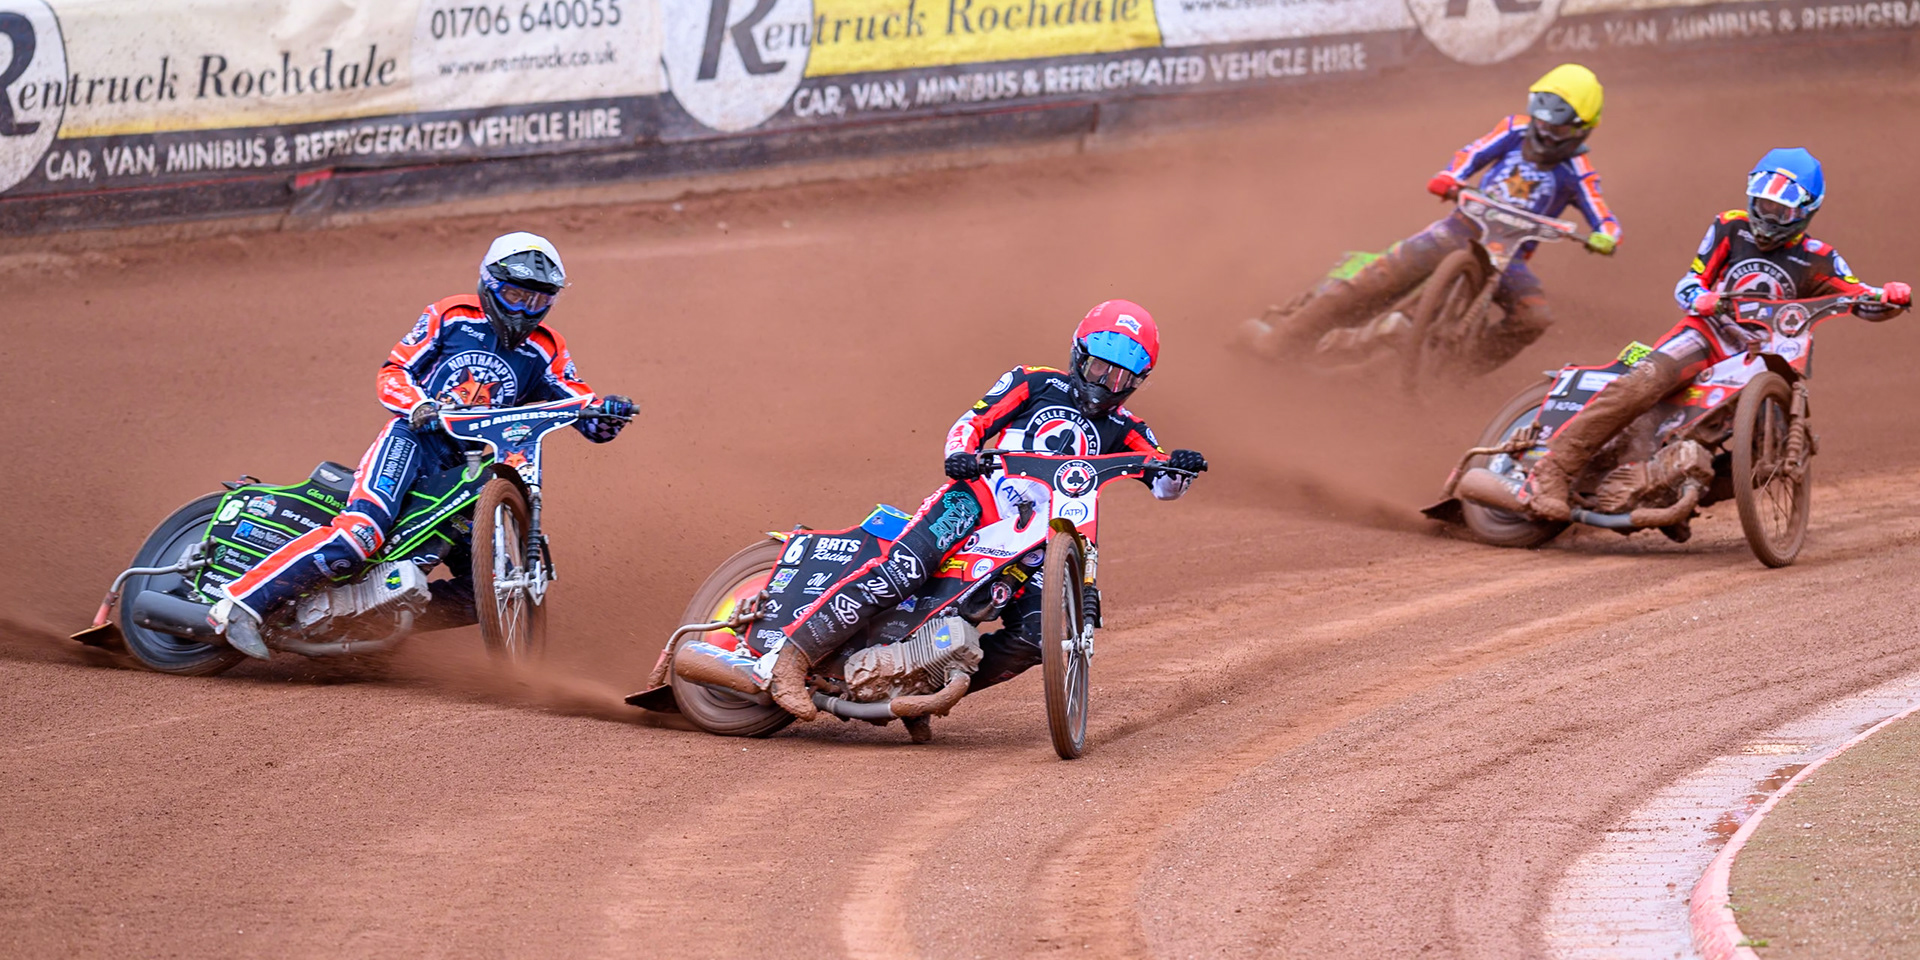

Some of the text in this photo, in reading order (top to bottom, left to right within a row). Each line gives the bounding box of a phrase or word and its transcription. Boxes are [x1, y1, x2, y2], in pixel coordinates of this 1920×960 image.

[431, 0, 622, 40] 01706 640055
[196, 44, 397, 100] Rochdale
[916, 70, 1019, 105] MINIBUS
[1022, 69, 1042, 95] &
[1044, 55, 1205, 93] REFRIGERATED
[1209, 47, 1308, 82] VEHICLE
[1312, 43, 1367, 74] HIRE
[45, 107, 622, 184] CAR, VAN, MINIBUS & REFRIGERATED VEHICLE HIRE
[447, 353, 516, 397] NORTHAMPTON
[1034, 410, 1066, 426] BELLE
[1070, 413, 1090, 431] VUE
[306, 488, 325, 501] Glen
[217, 499, 244, 522] 6
[281, 509, 301, 522] Dirt
[1063, 508, 1083, 516] ATPI
[783, 536, 807, 564] 6
[815, 537, 862, 553] BRTS
[810, 549, 853, 566] Racing
